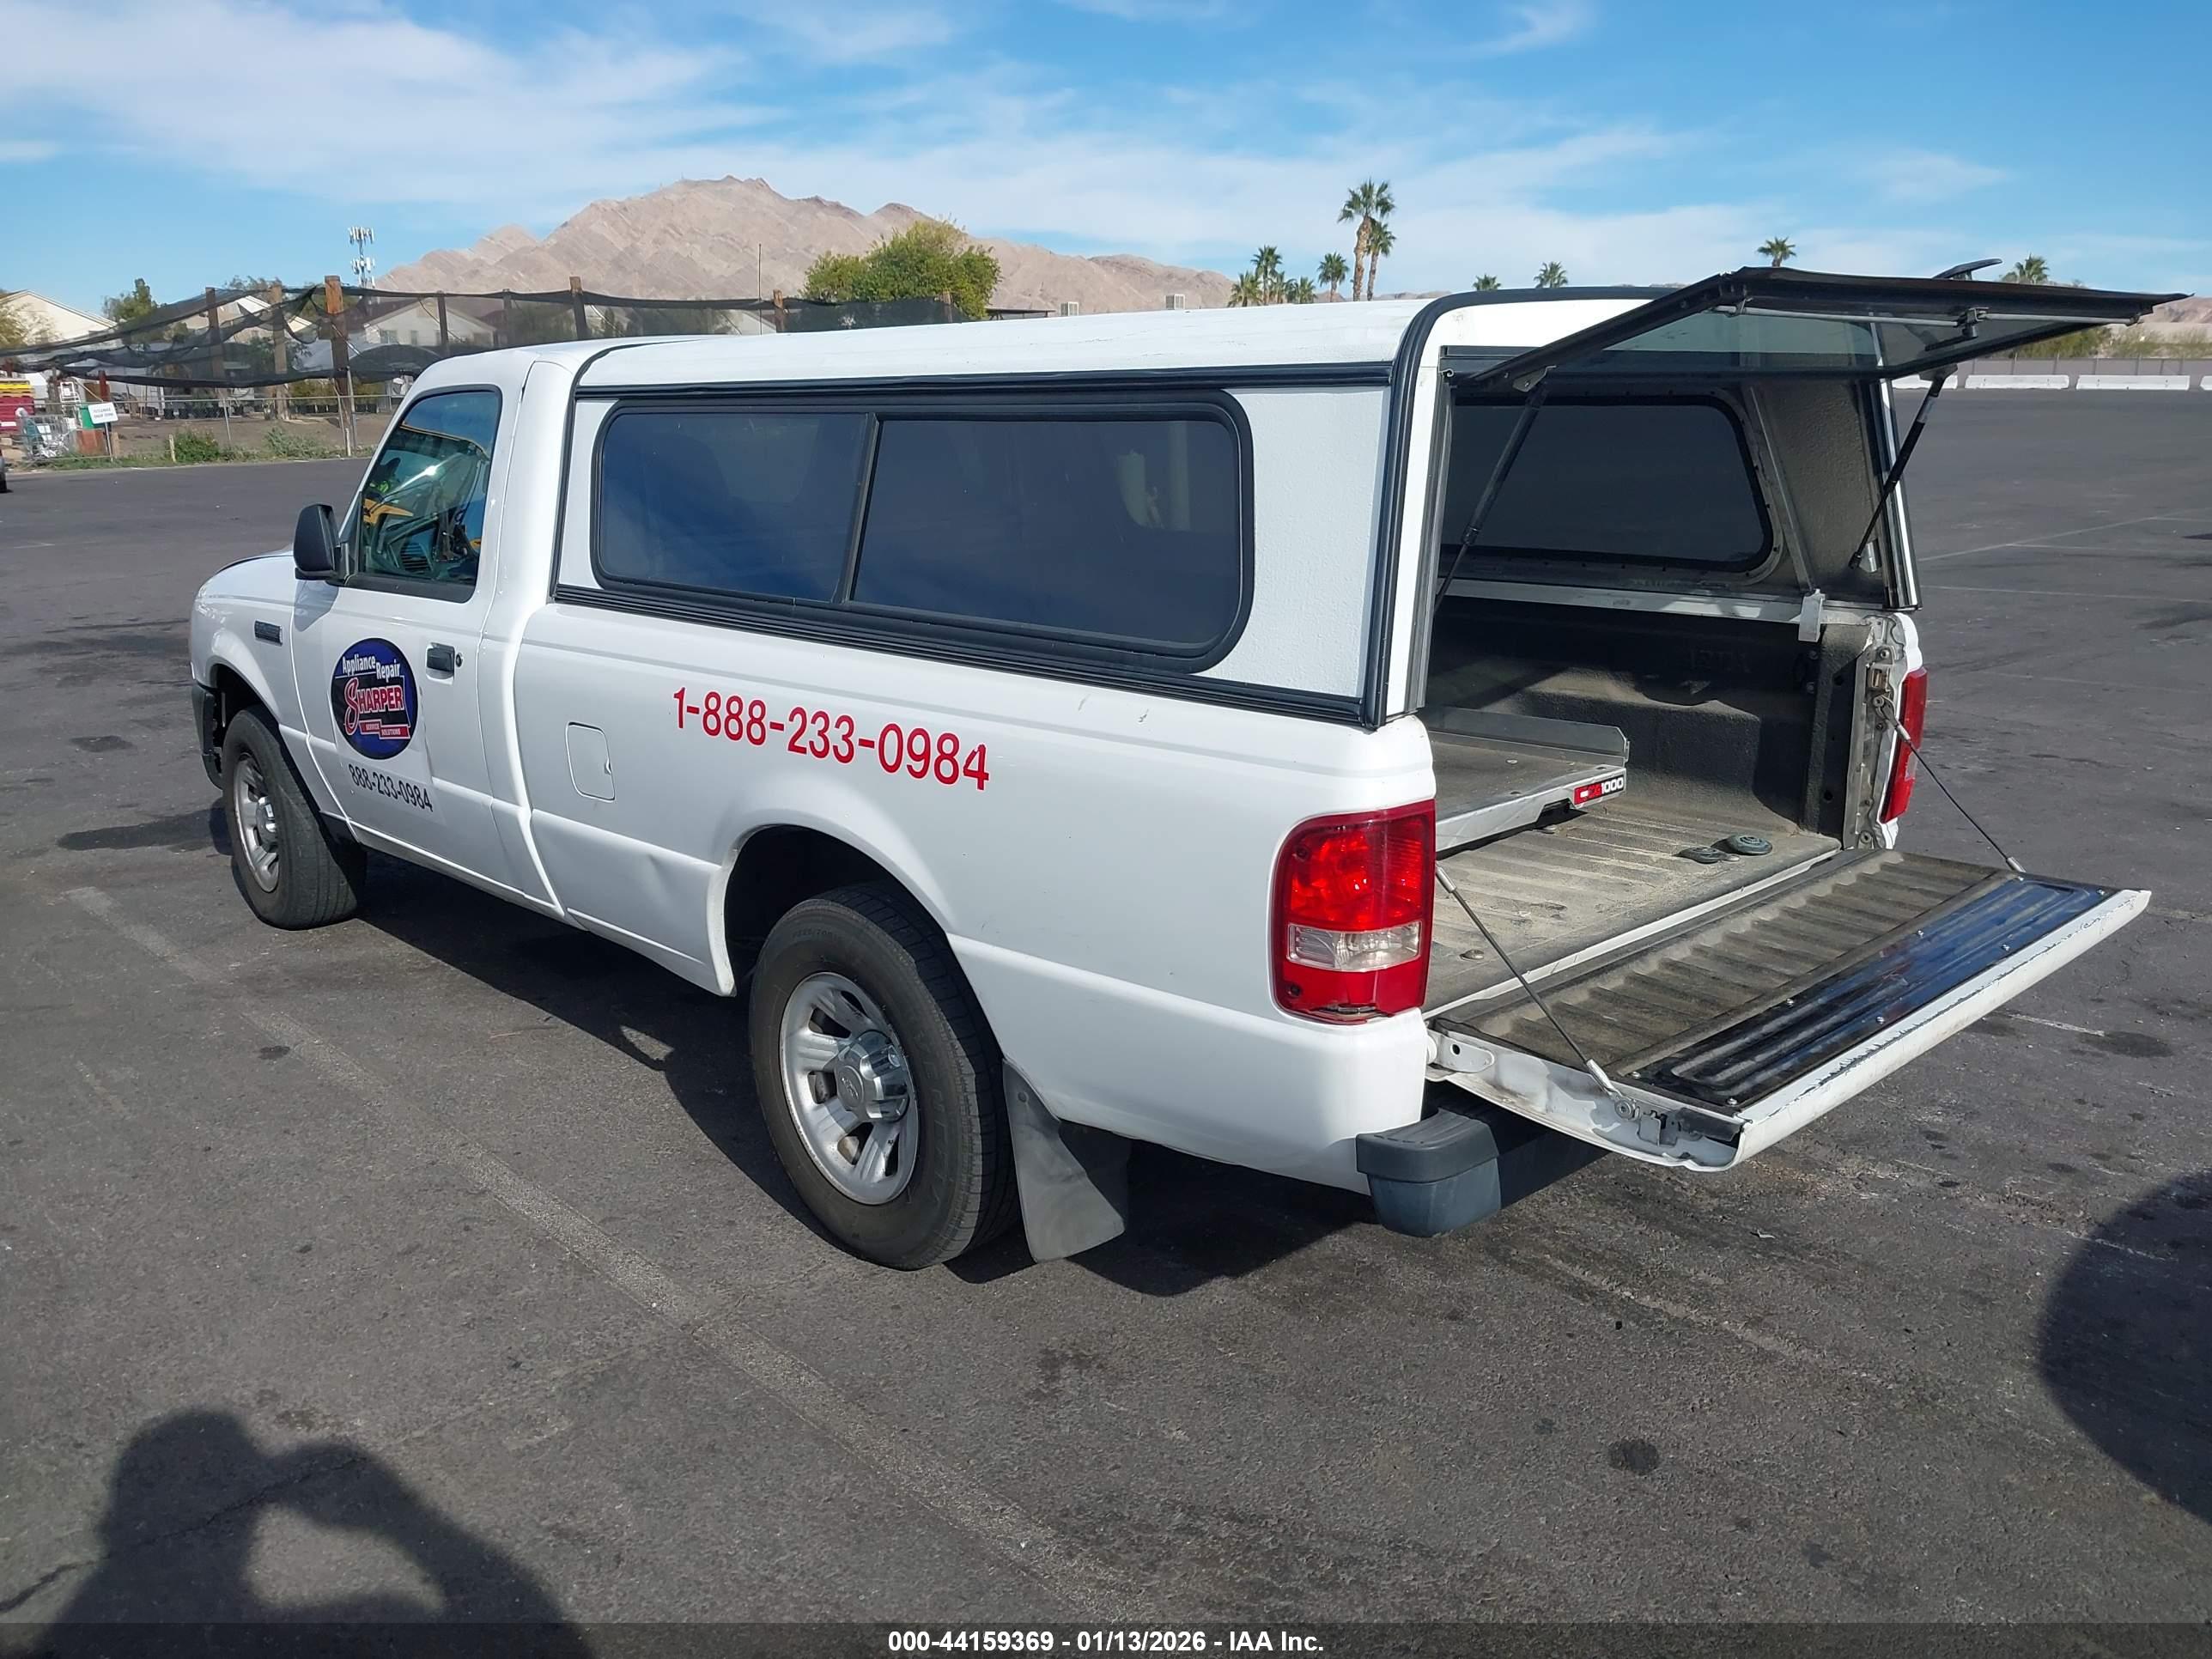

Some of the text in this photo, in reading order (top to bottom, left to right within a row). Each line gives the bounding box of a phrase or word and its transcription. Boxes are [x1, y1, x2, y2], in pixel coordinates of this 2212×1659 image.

[342, 653, 401, 683] Appliance Repair
[673, 687, 990, 790] 1-888-233-0984
[349, 763, 434, 812] 888-233-0984
